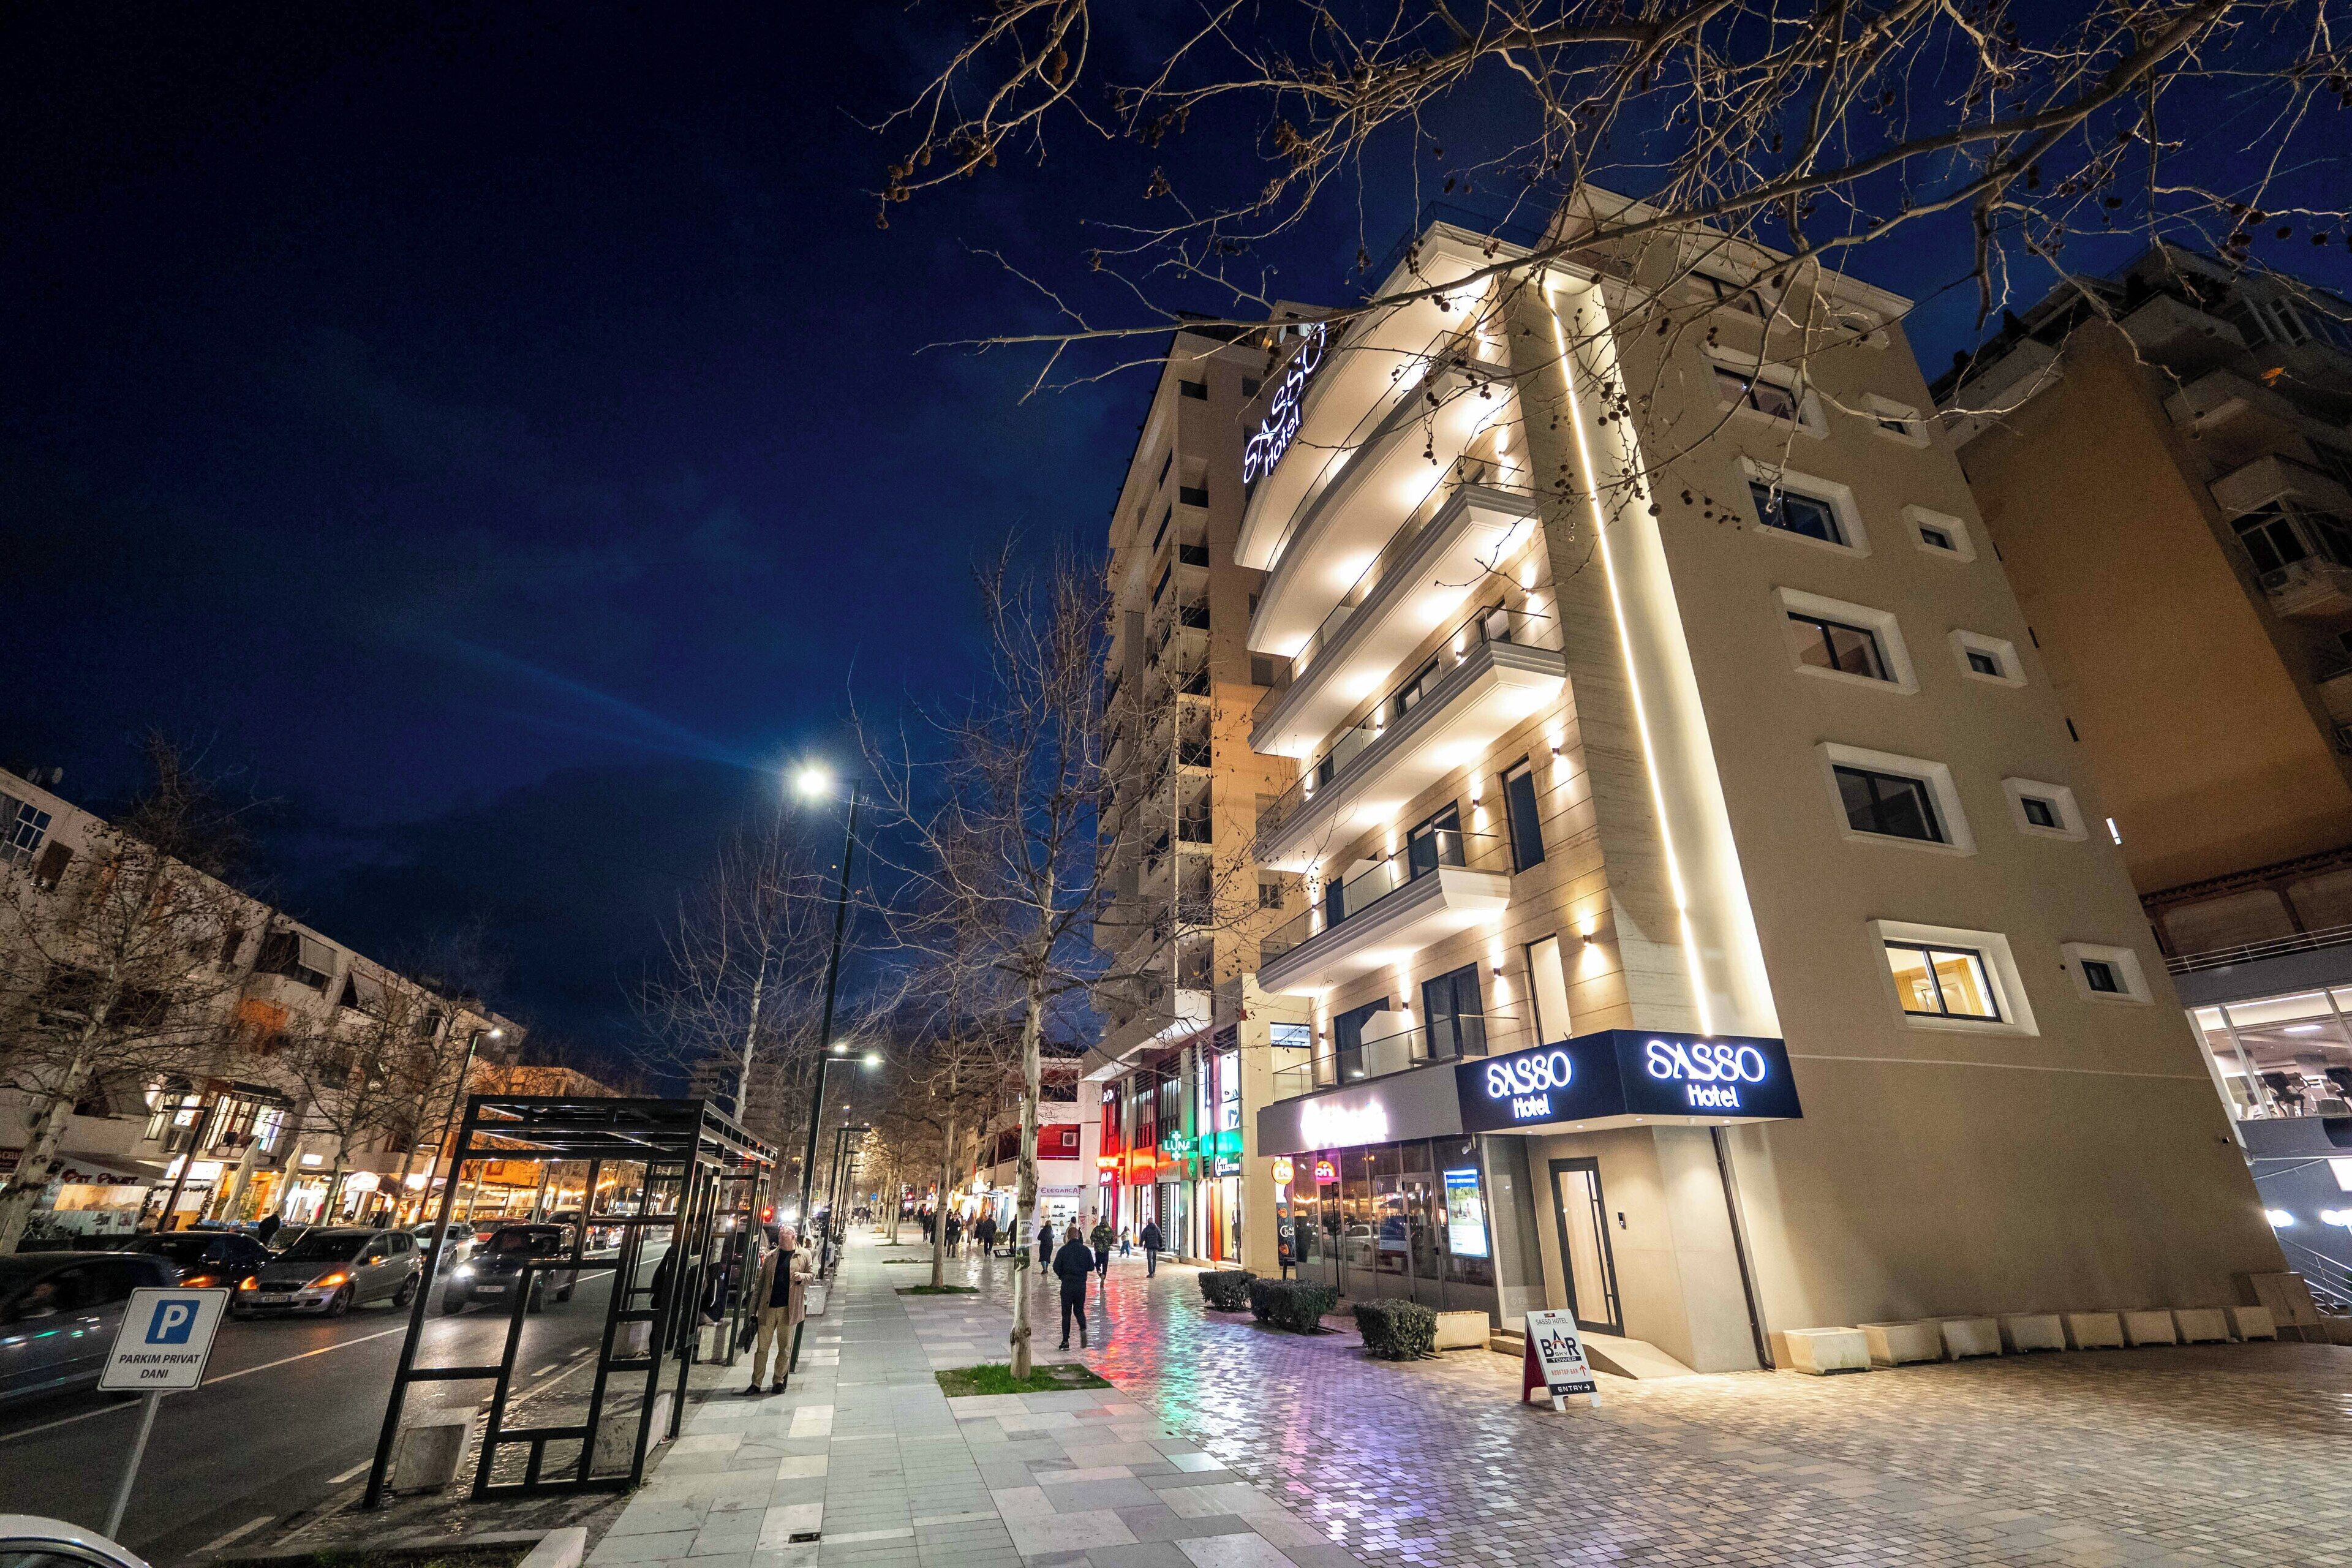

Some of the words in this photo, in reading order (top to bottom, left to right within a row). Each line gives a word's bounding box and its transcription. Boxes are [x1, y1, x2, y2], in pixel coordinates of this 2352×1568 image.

[1243, 322, 1326, 484] SASSO
[1265, 404, 1300, 477] Hotel
[1487, 1051, 1572, 1098] SASSO
[1647, 1039, 1766, 1082] SASSO
[1513, 1093, 1551, 1118] Hotel
[1687, 1084, 1740, 1107] Hotel
[156, 1304, 189, 1339] P
[119, 1354, 160, 1363] PARKIM
[162, 1354, 201, 1363] PRIVAT
[1540, 1328, 1580, 1357] BAR
[140, 1369, 168, 1378] DANI
